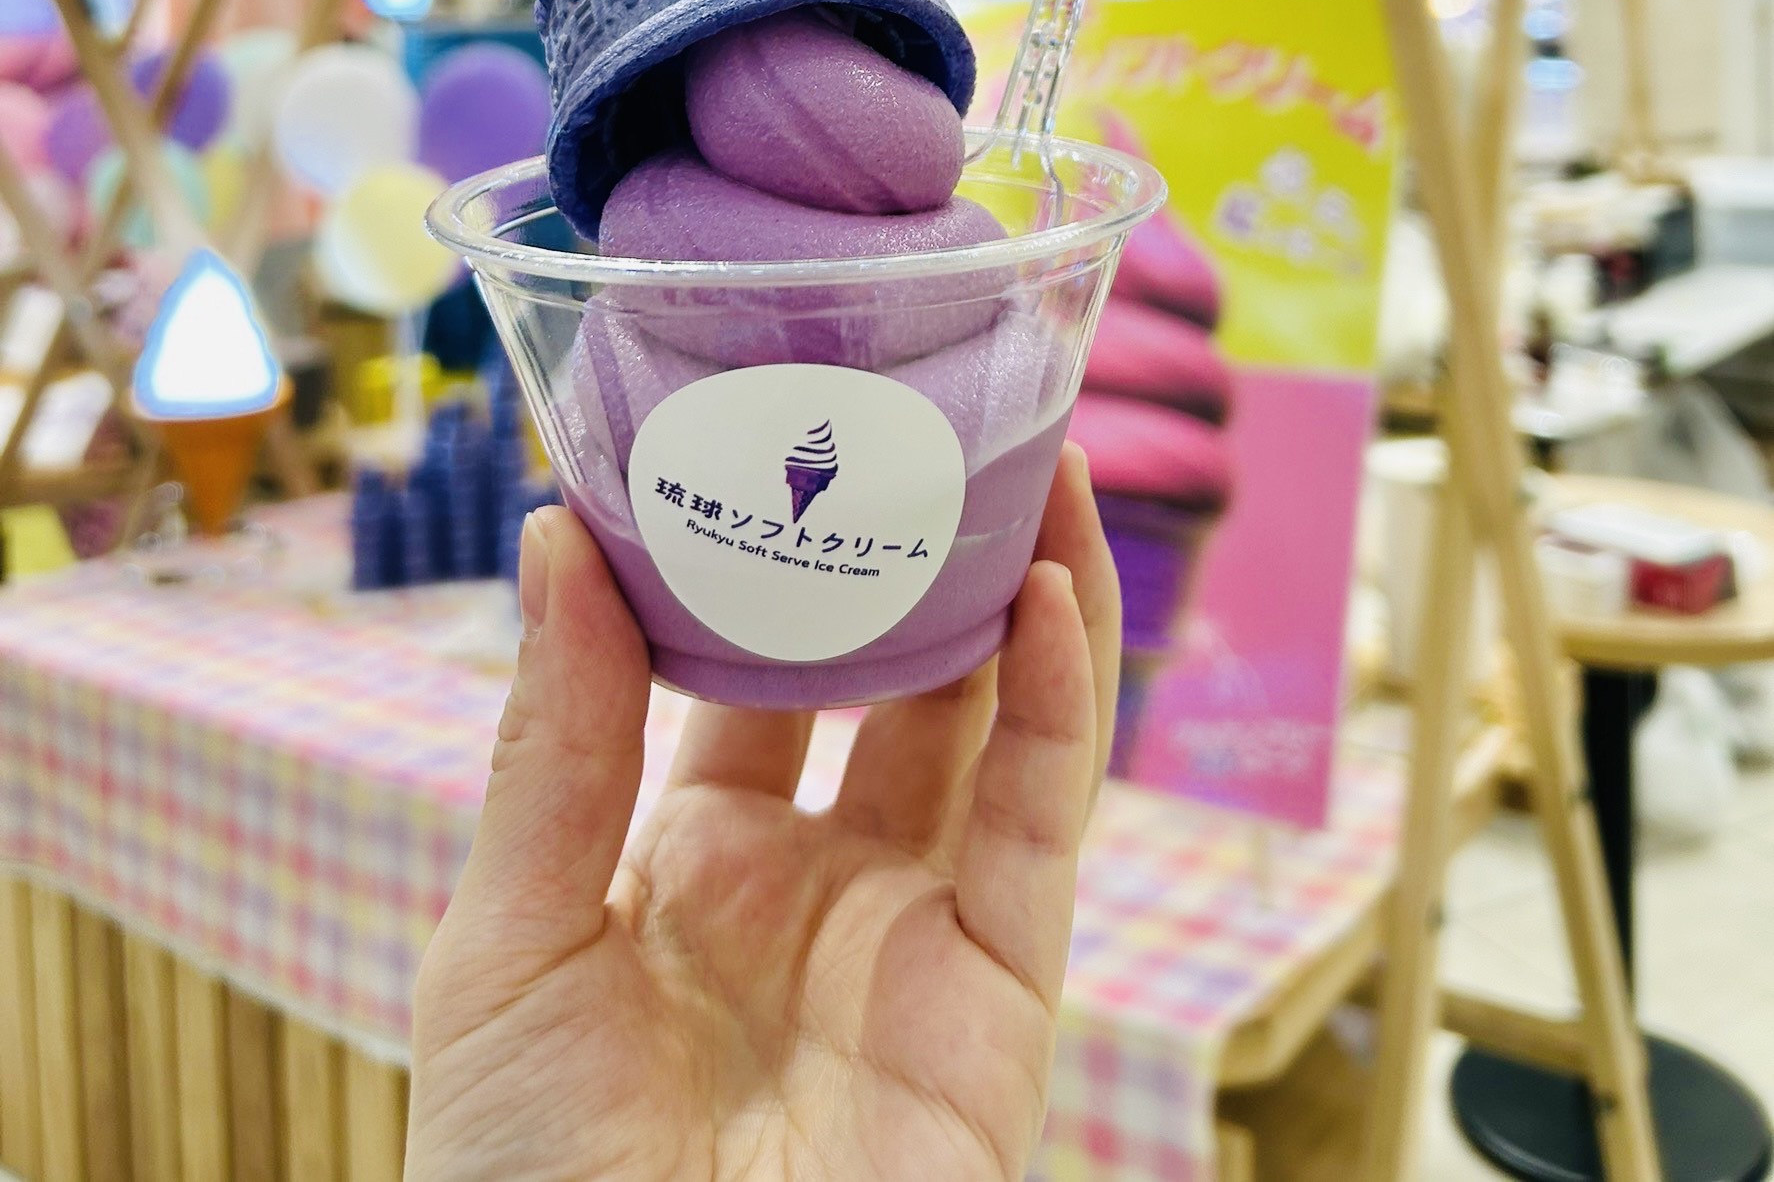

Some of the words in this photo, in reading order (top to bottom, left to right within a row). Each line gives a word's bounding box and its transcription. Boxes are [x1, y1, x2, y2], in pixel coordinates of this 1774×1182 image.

[655, 477, 928, 558] 琉球ソフトクリーム
[686, 519, 735, 547] Ryukyu
[738, 540, 768, 558] Soft
[771, 550, 810, 568] Serve
[814, 560, 835, 573] Ice
[838, 564, 880, 577] Cream
